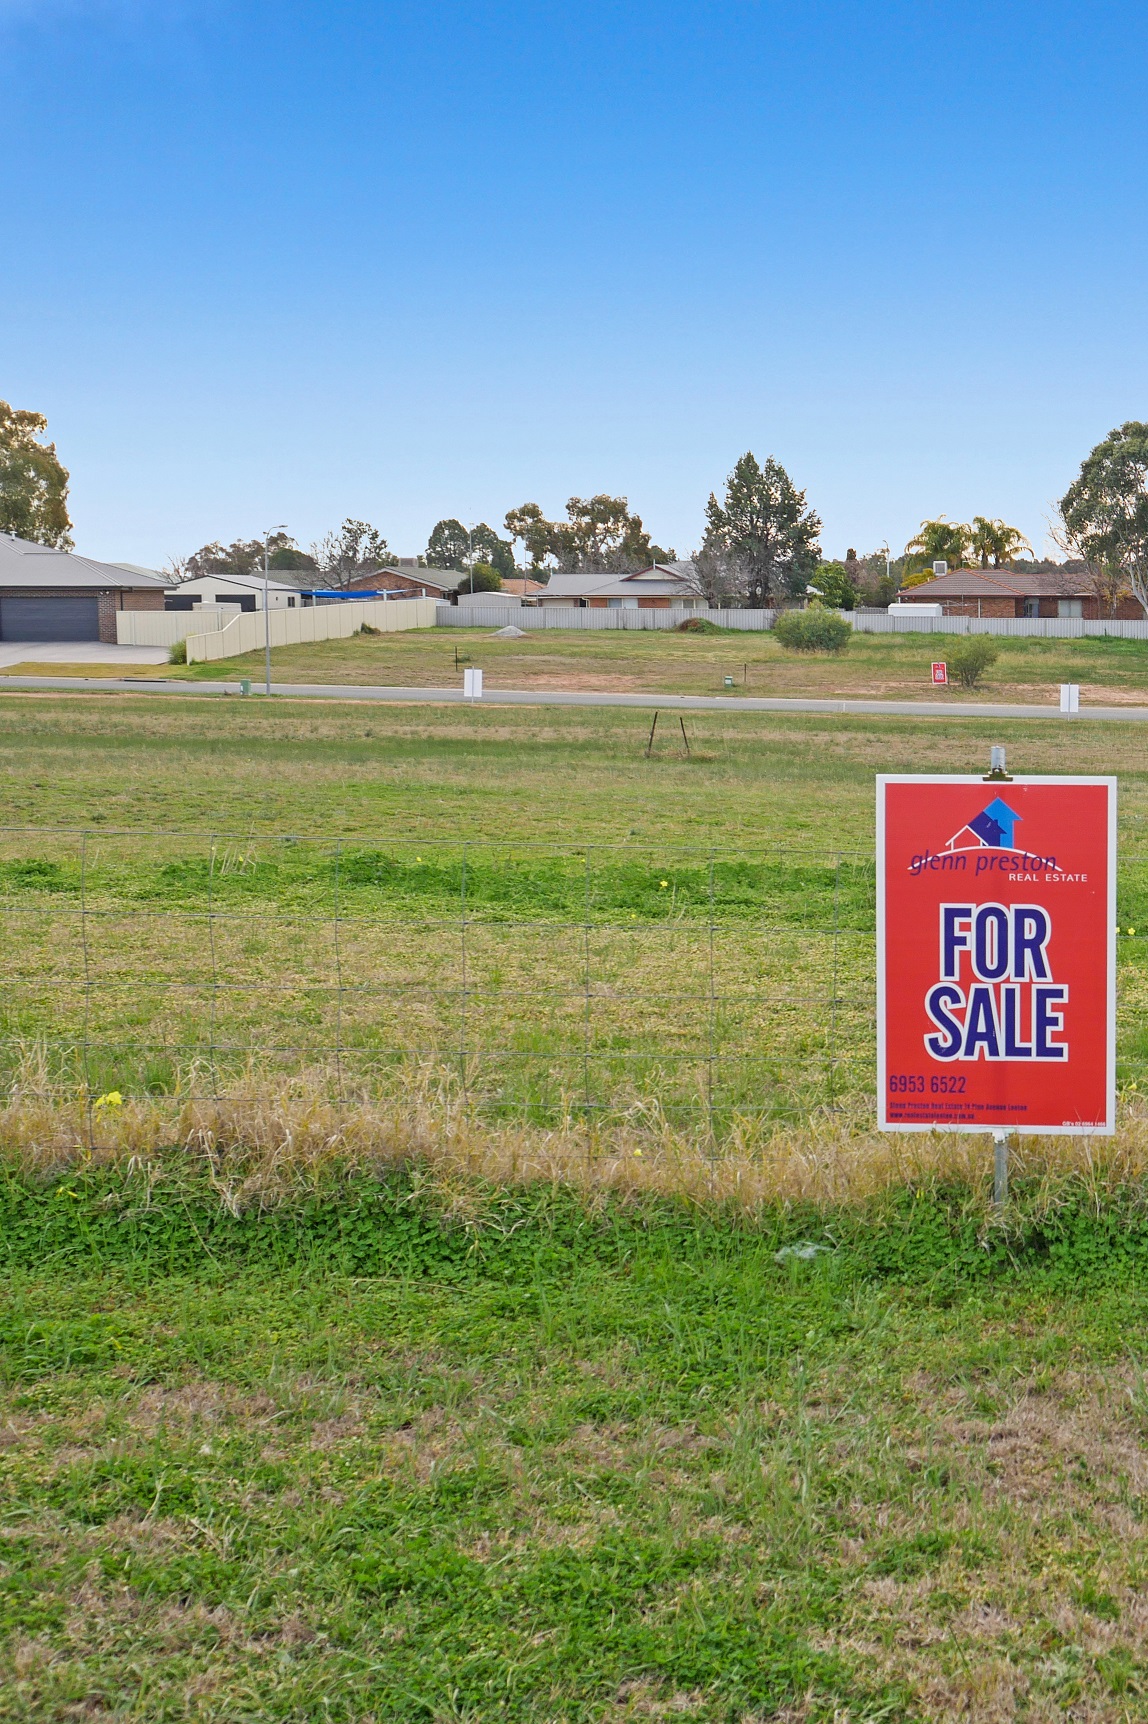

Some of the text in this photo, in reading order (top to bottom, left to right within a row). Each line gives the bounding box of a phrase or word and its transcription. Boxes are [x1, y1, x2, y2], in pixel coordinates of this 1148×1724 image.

[911, 850, 1056, 876] glenn preston
[1008, 873, 1088, 882] REAL ESTATE
[940, 902, 1053, 983] FOR
[924, 982, 1069, 1062] SALE
[889, 1075, 967, 1093] 6953 6522
